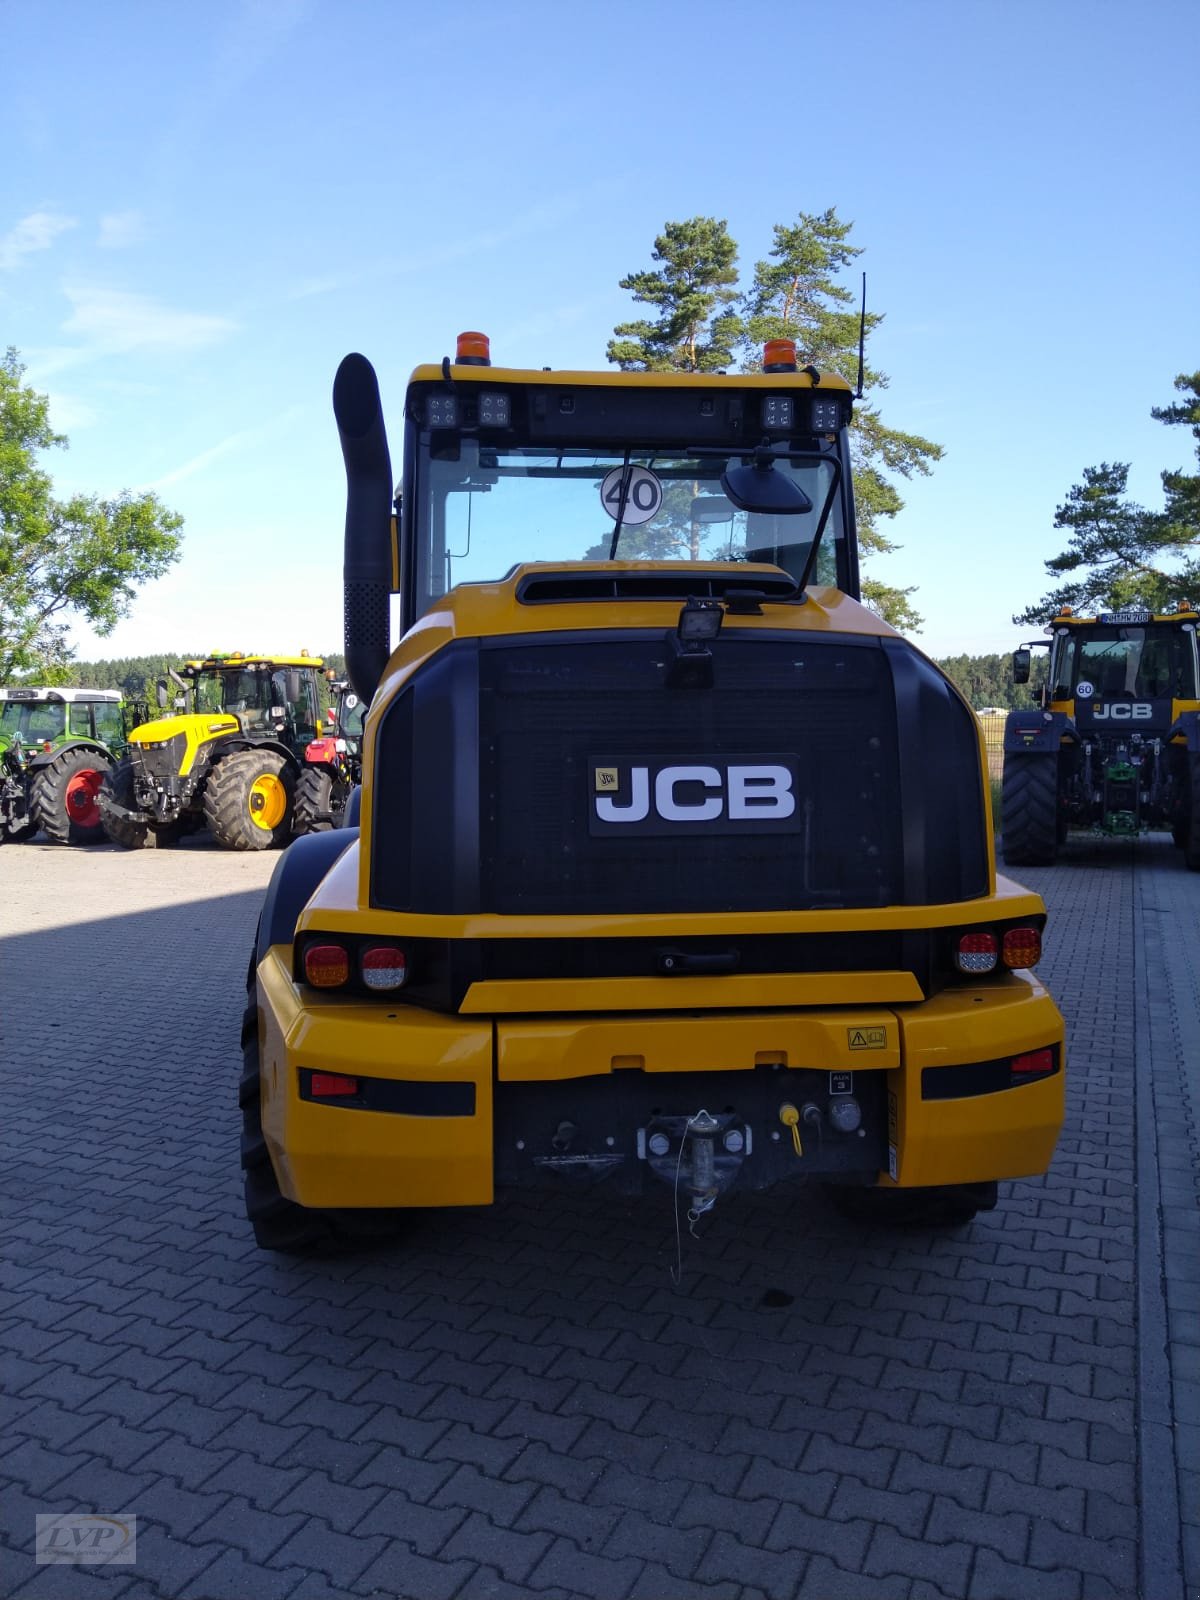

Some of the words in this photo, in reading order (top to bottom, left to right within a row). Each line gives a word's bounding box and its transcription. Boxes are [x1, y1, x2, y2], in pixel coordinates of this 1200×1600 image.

[605, 479, 658, 511] 40
[1079, 686, 1092, 694] 60
[1093, 703, 1153, 719] JCB
[595, 765, 796, 823] JCB
